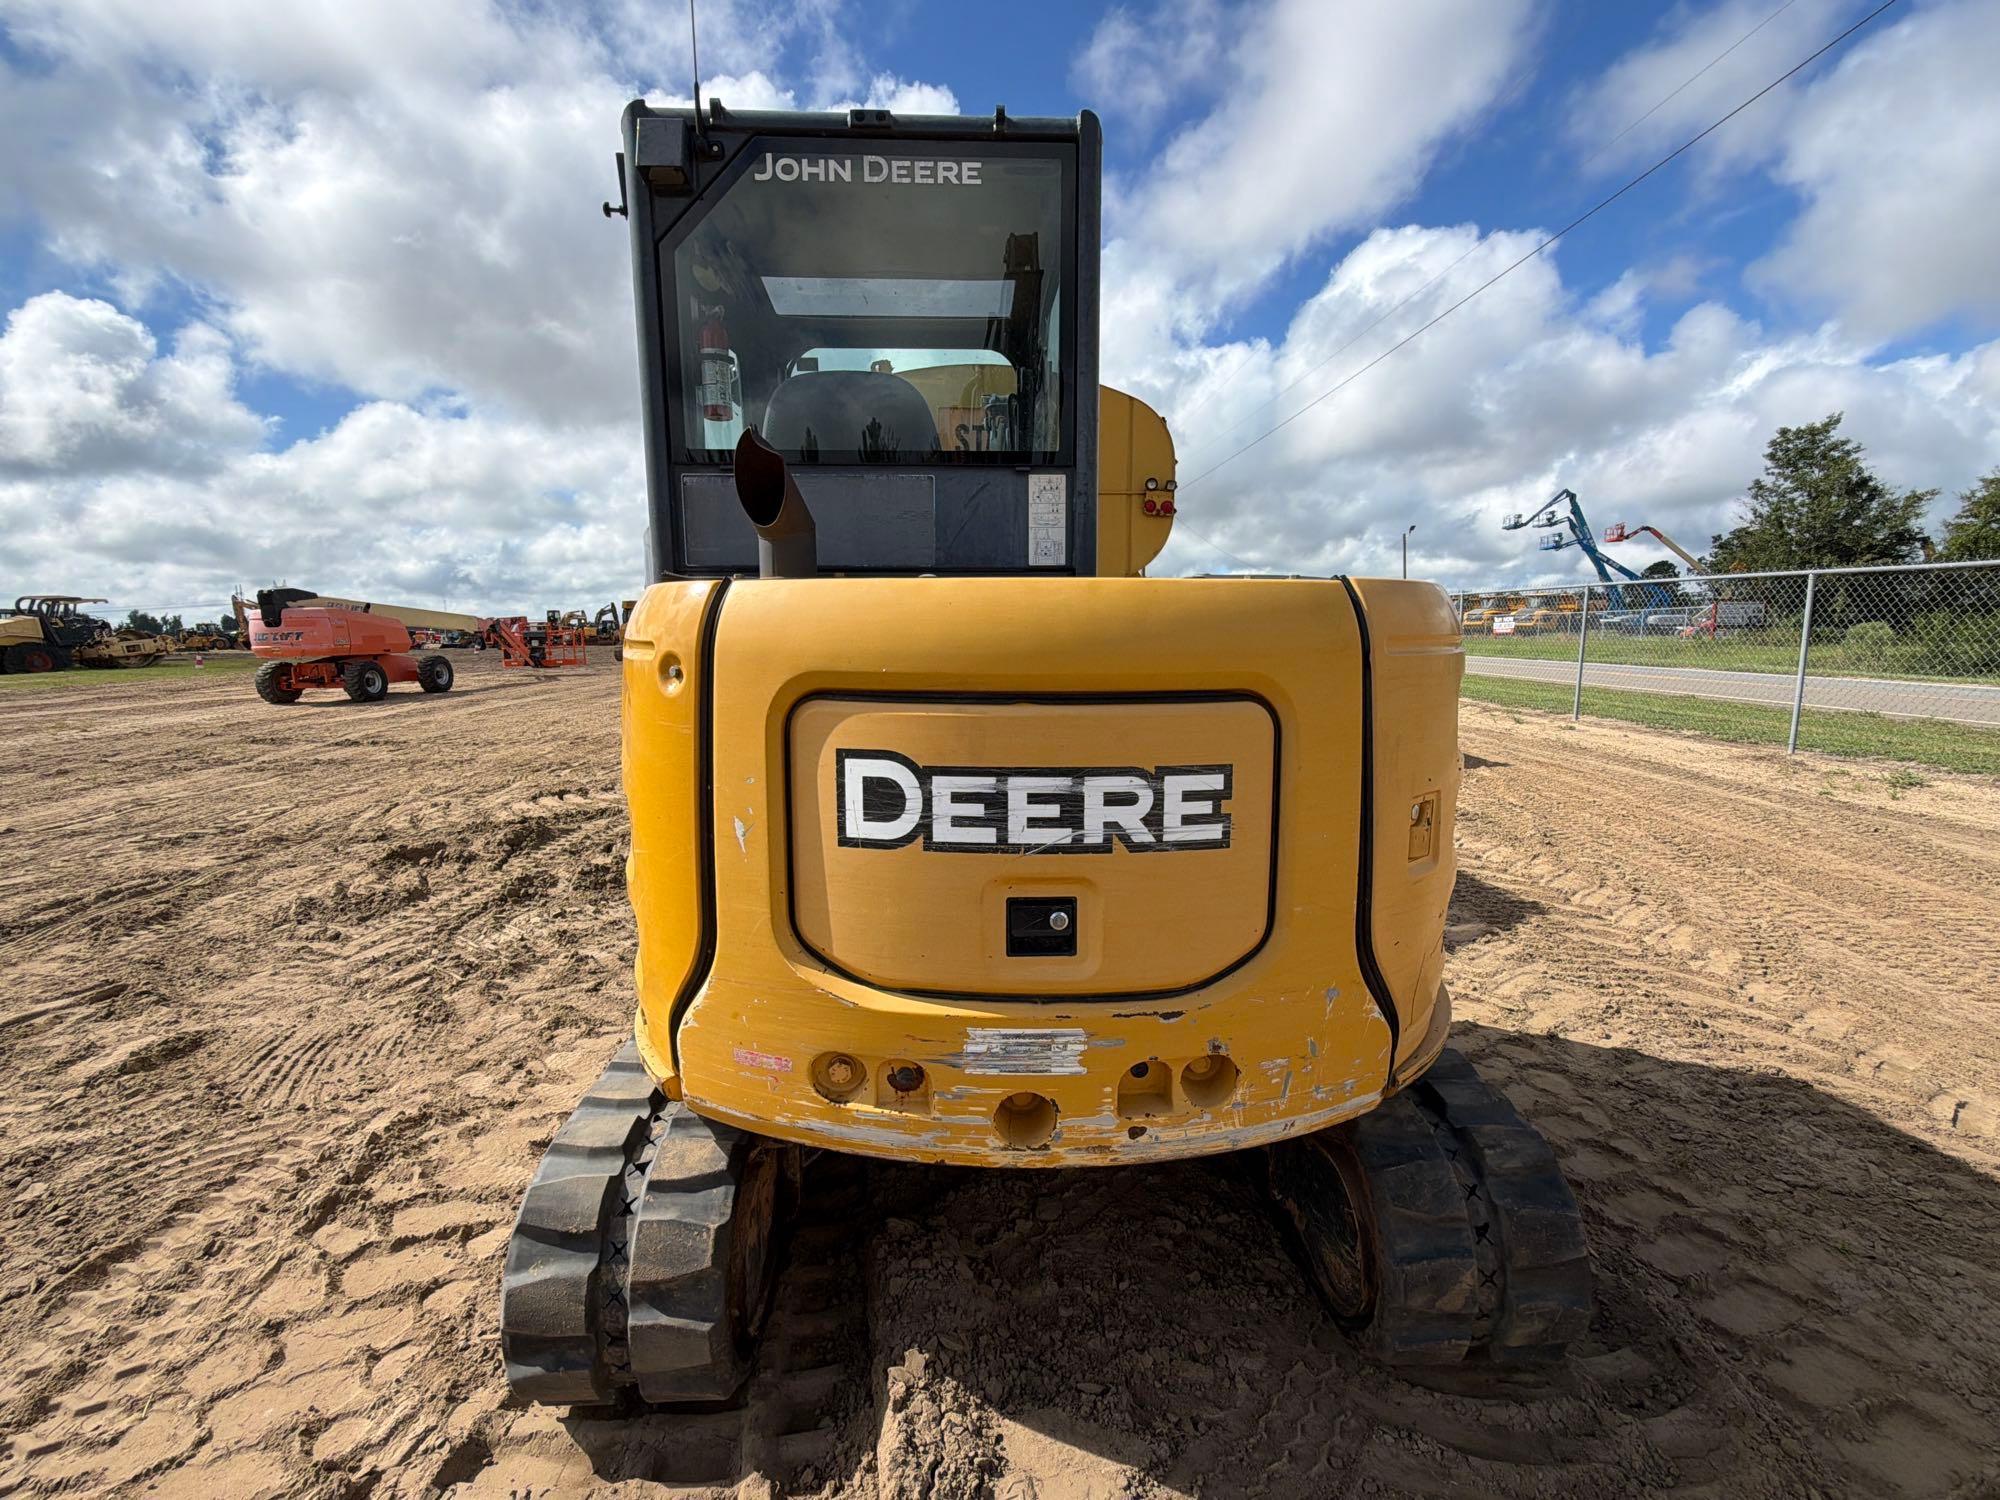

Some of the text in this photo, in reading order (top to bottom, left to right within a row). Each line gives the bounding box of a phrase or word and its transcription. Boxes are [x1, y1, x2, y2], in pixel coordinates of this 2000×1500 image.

[754, 153, 982, 184] JOHN DEERE
[844, 758, 1225, 844] DEERE
